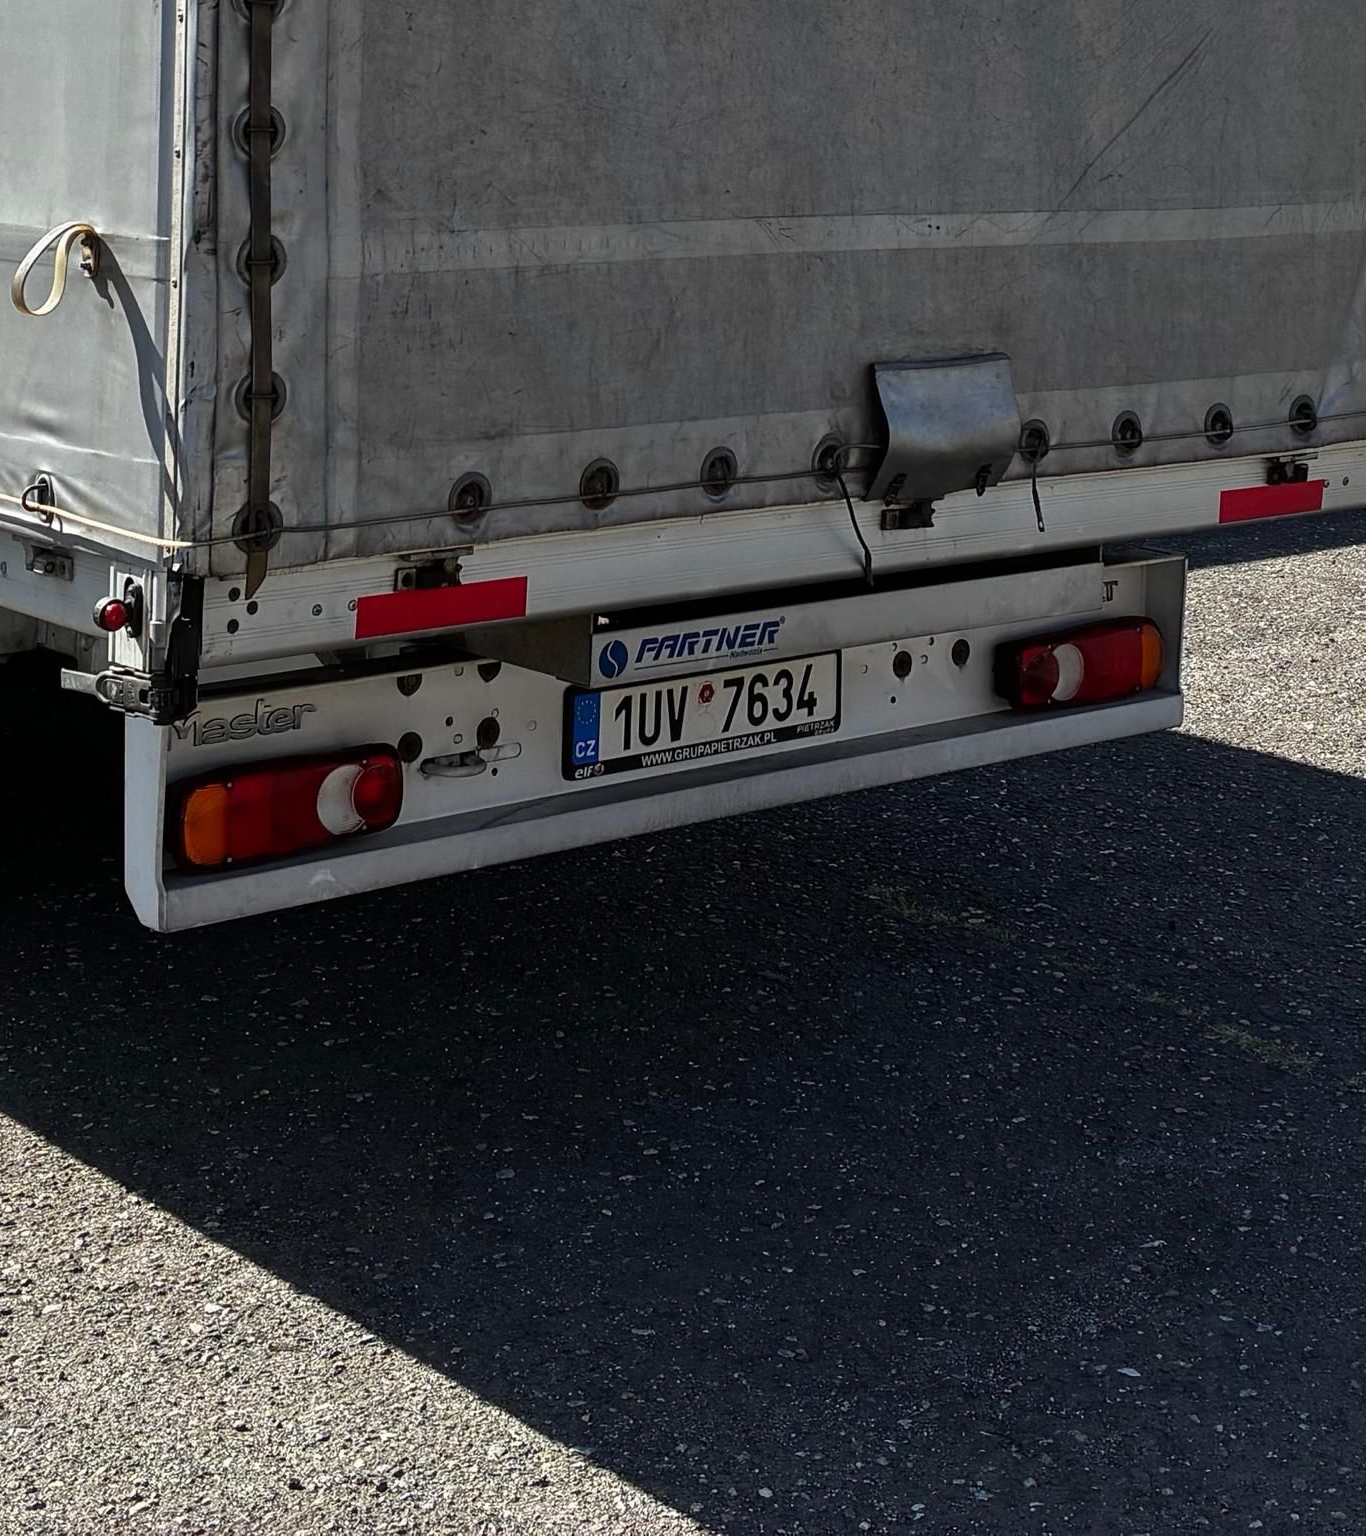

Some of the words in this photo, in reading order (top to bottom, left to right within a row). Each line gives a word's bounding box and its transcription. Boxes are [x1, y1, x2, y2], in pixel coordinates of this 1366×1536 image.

[635, 621, 780, 663] PARTNER
[615, 686, 688, 750] 1UV
[722, 664, 817, 733] 7634
[796, 719, 835, 734] PIETRZAK
[575, 739, 596, 758] CZ
[641, 732, 778, 767] WWW.GRUPAPIETRZAK.PL
[574, 765, 594, 779] elf
